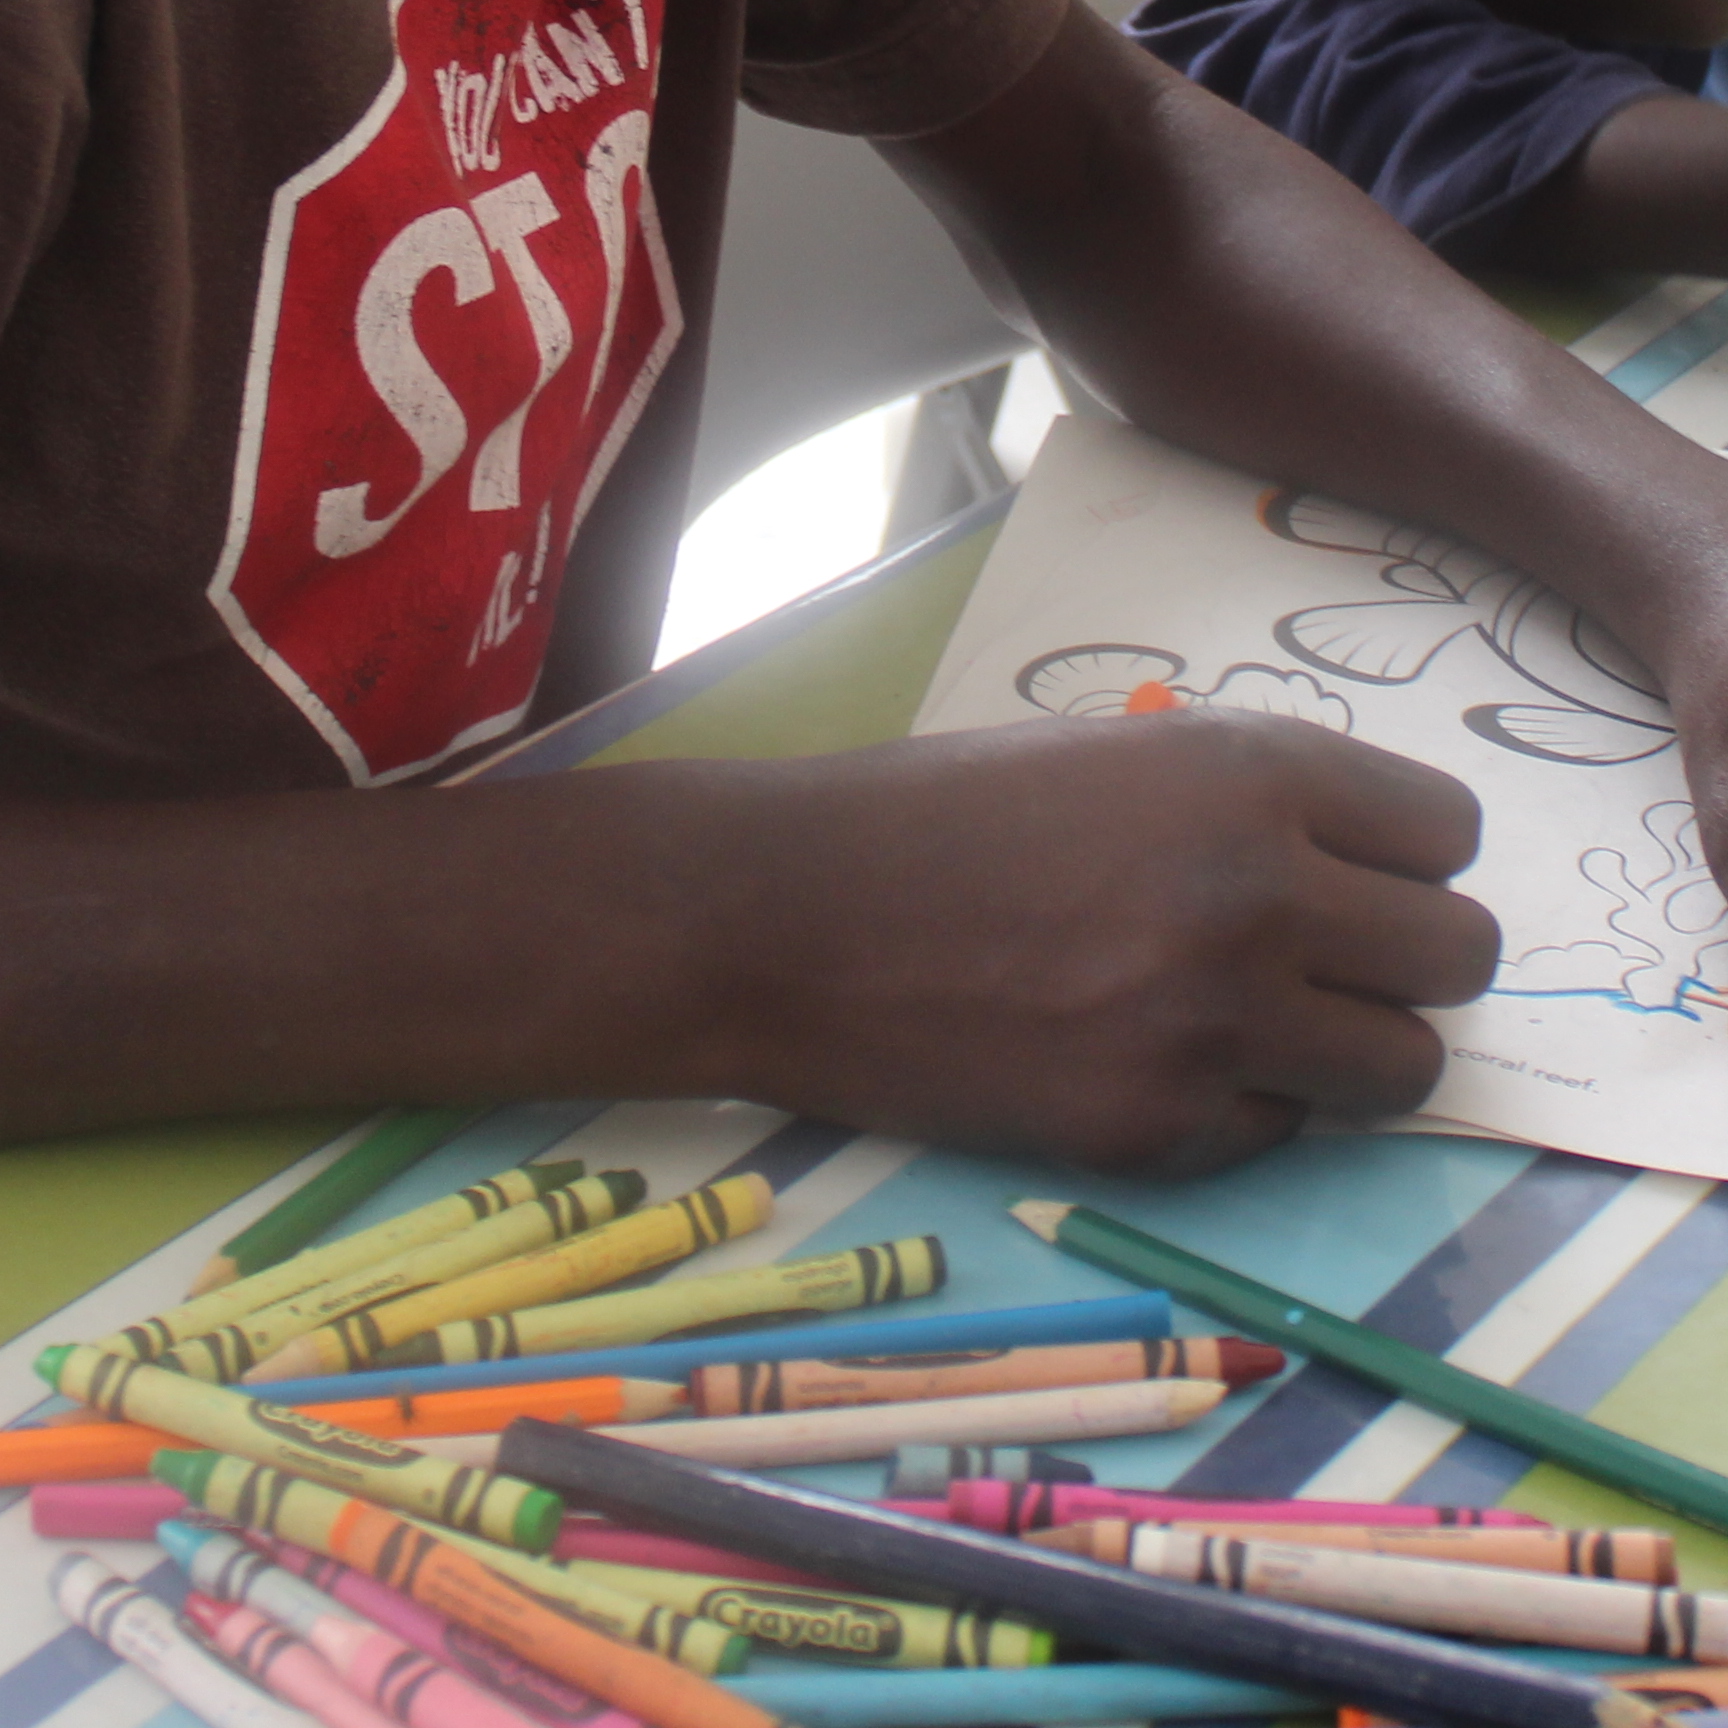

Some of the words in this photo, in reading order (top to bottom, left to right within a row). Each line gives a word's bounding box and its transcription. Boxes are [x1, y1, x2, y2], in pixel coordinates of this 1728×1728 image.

[1452, 1047, 1528, 1073] coral
[1532, 1068, 1601, 1094] reef.
[706, 1591, 880, 1655] Crayola
